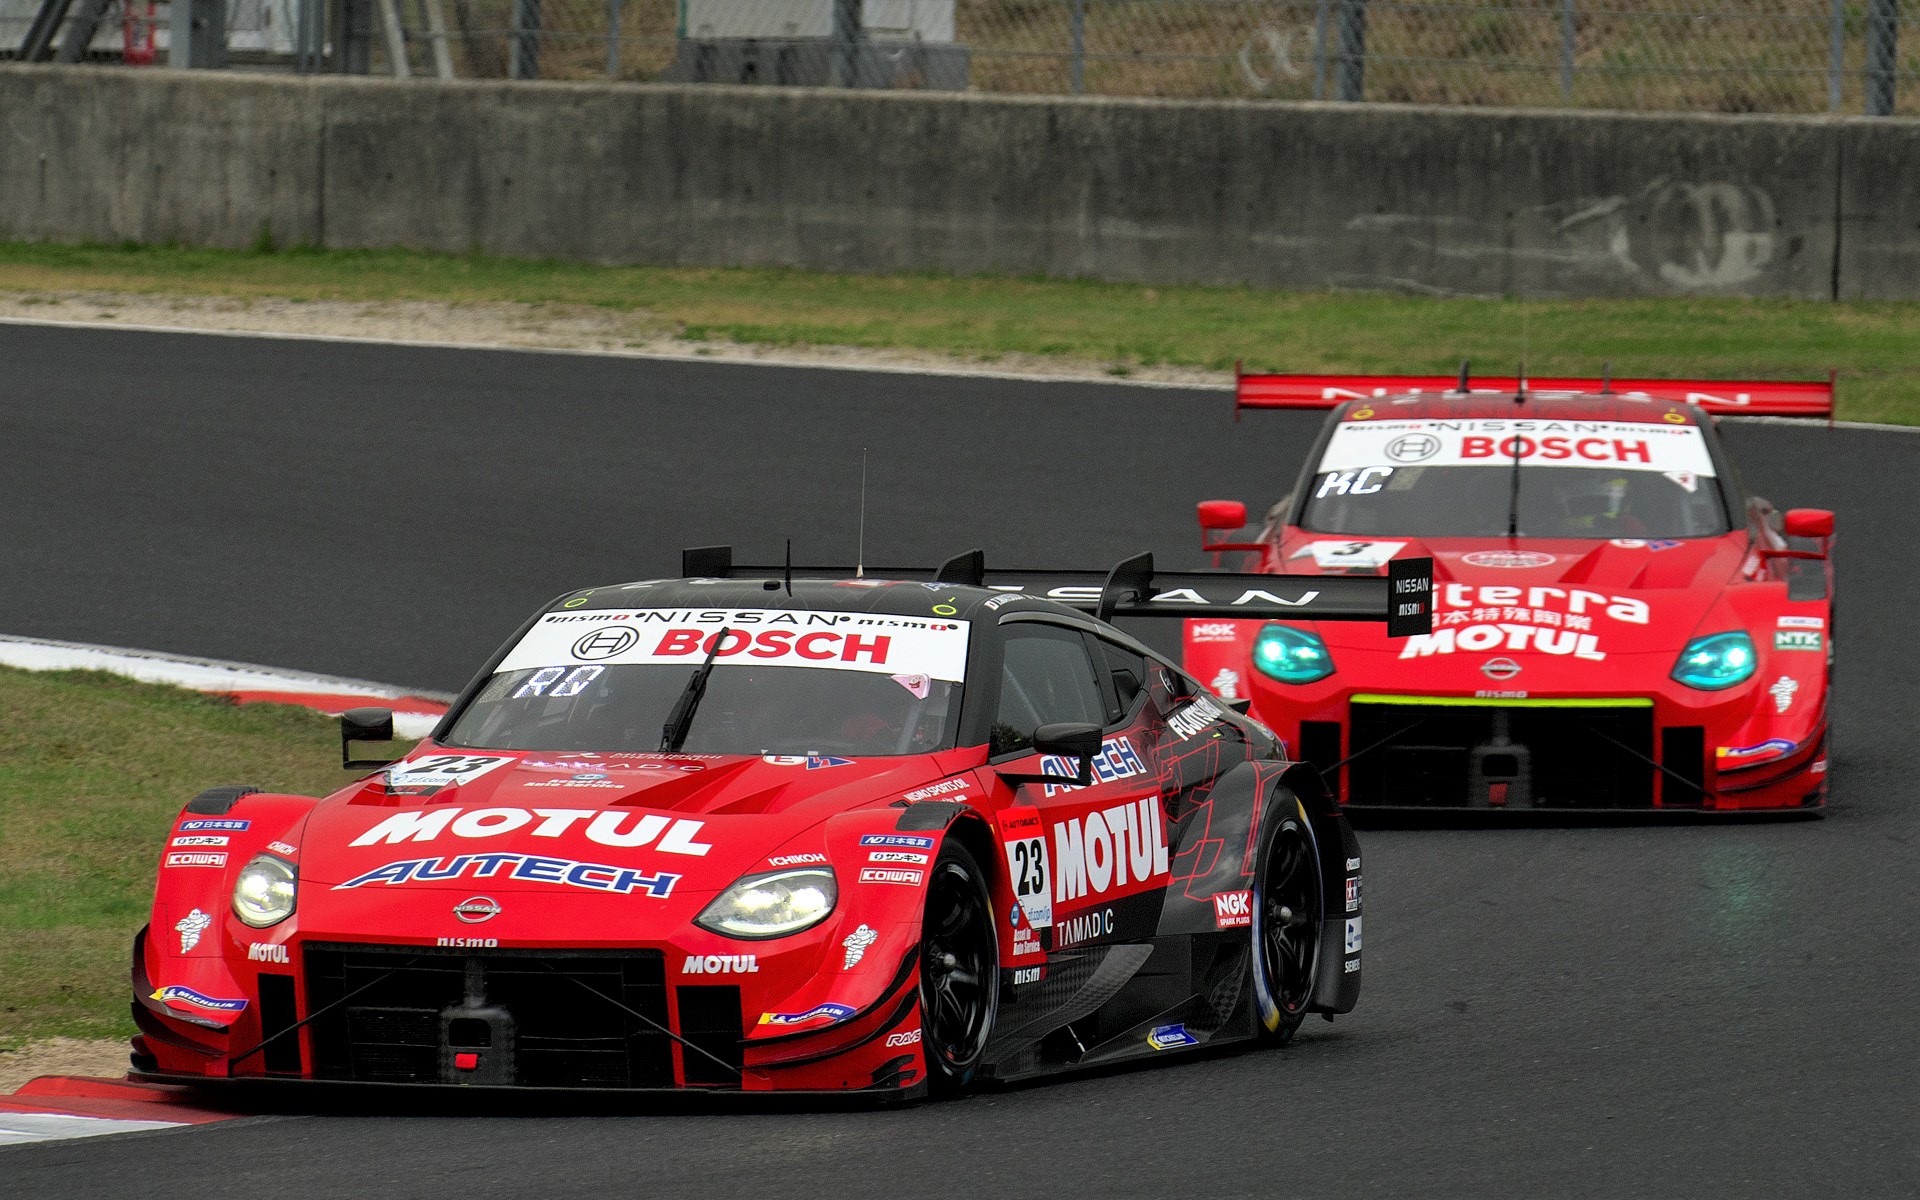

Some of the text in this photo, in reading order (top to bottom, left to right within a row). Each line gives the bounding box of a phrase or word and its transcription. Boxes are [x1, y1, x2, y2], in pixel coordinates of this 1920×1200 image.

[1437, 420, 1598, 432] NISSAN
[1460, 435, 1652, 464] BOSCH
[1315, 466, 1394, 499] KC
[1332, 542, 1373, 556] 3
[1396, 577, 1429, 594] NISSAN
[1432, 583, 1649, 625] iterra
[553, 613, 629, 624] nismo
[644, 611, 838, 626] NISSAN
[857, 619, 947, 632] nismo
[1192, 624, 1236, 636] NGK
[1775, 632, 1821, 645] NTK
[652, 629, 891, 664] BOSCH
[1398, 623, 1607, 661] MOTUL
[404, 755, 501, 774] 23
[903, 789, 931, 802] NISMO
[927, 781, 956, 796] SPORTS
[953, 778, 970, 789] OIL
[347, 807, 713, 857] MOTUL
[1053, 795, 1169, 904] MOTUL
[768, 852, 827, 867] ICHIKOH
[1015, 839, 1044, 896] 23
[329, 852, 683, 899] AUTECH
[452, 903, 502, 914] NISSAN
[1215, 892, 1250, 916] NGK
[1056, 908, 1114, 947] TAMADIC
[1219, 916, 1251, 927] SPARK PLUGS
[437, 937, 498, 948] nismo
[248, 942, 290, 964] MOTUL
[681, 954, 760, 974] MOTUL
[179, 990, 236, 1008] MICHELIN
[788, 1007, 844, 1024] MICHELIN
